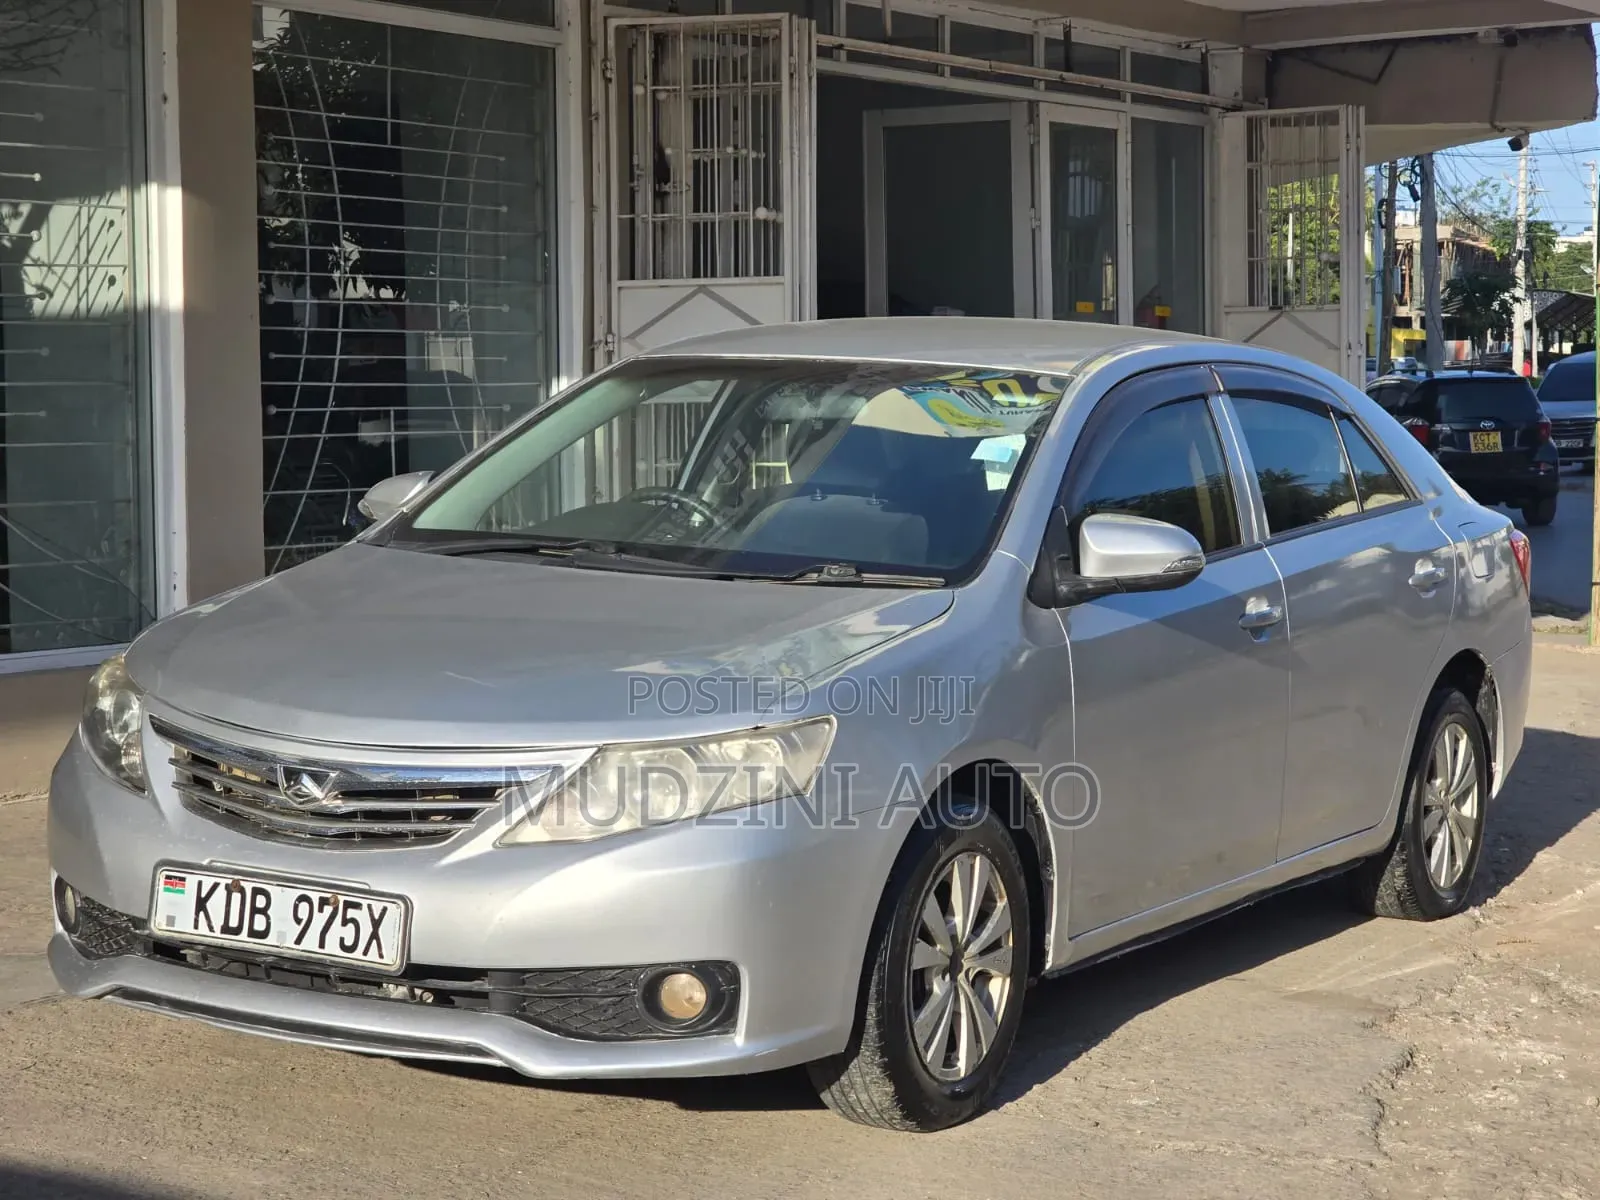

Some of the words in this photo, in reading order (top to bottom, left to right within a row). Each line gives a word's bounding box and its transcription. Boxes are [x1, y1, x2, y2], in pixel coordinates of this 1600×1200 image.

[1473, 433, 1491, 443] KCT
[193, 879, 272, 940] KDB
[292, 893, 388, 960] 975X
